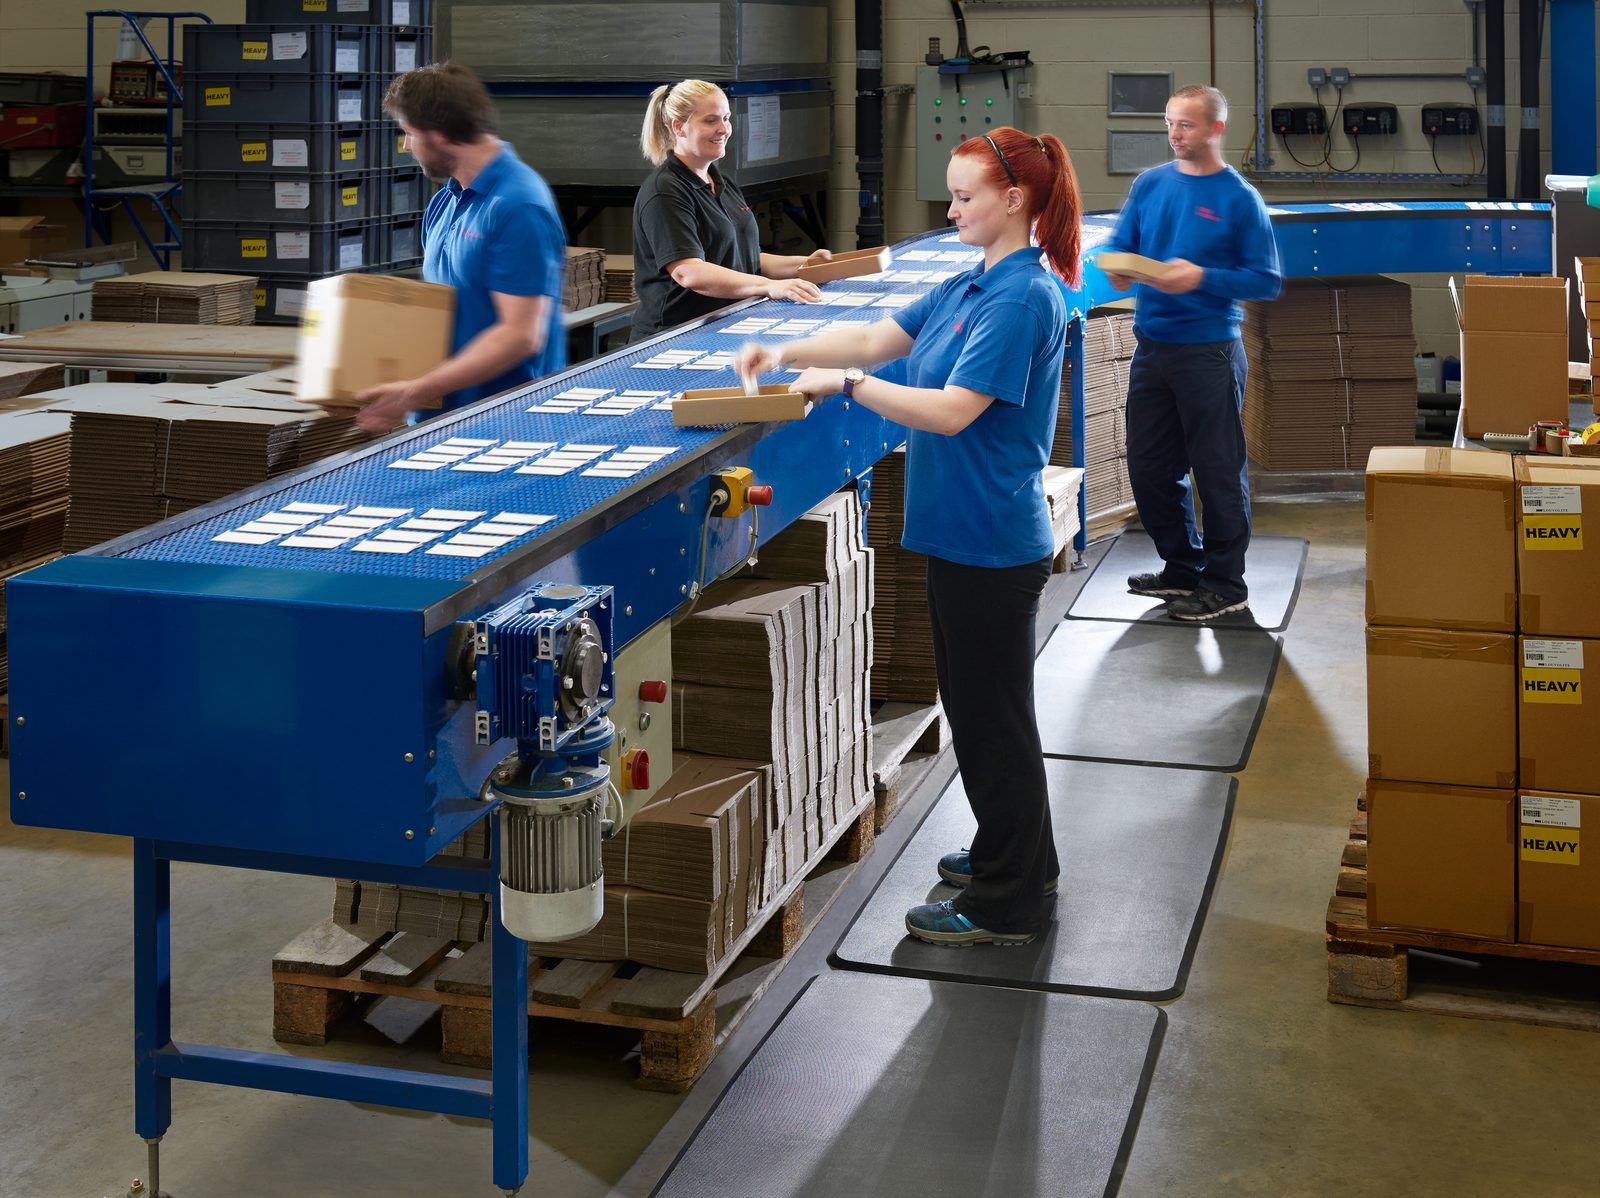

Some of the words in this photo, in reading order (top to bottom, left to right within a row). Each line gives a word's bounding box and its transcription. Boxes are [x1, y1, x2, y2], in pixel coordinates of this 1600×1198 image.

[242, 148, 266, 156] HEAVY
[1526, 528, 1580, 538] HEAVY
[1524, 680, 1580, 692] HEAVY
[1523, 838, 1578, 853] HEAVY
